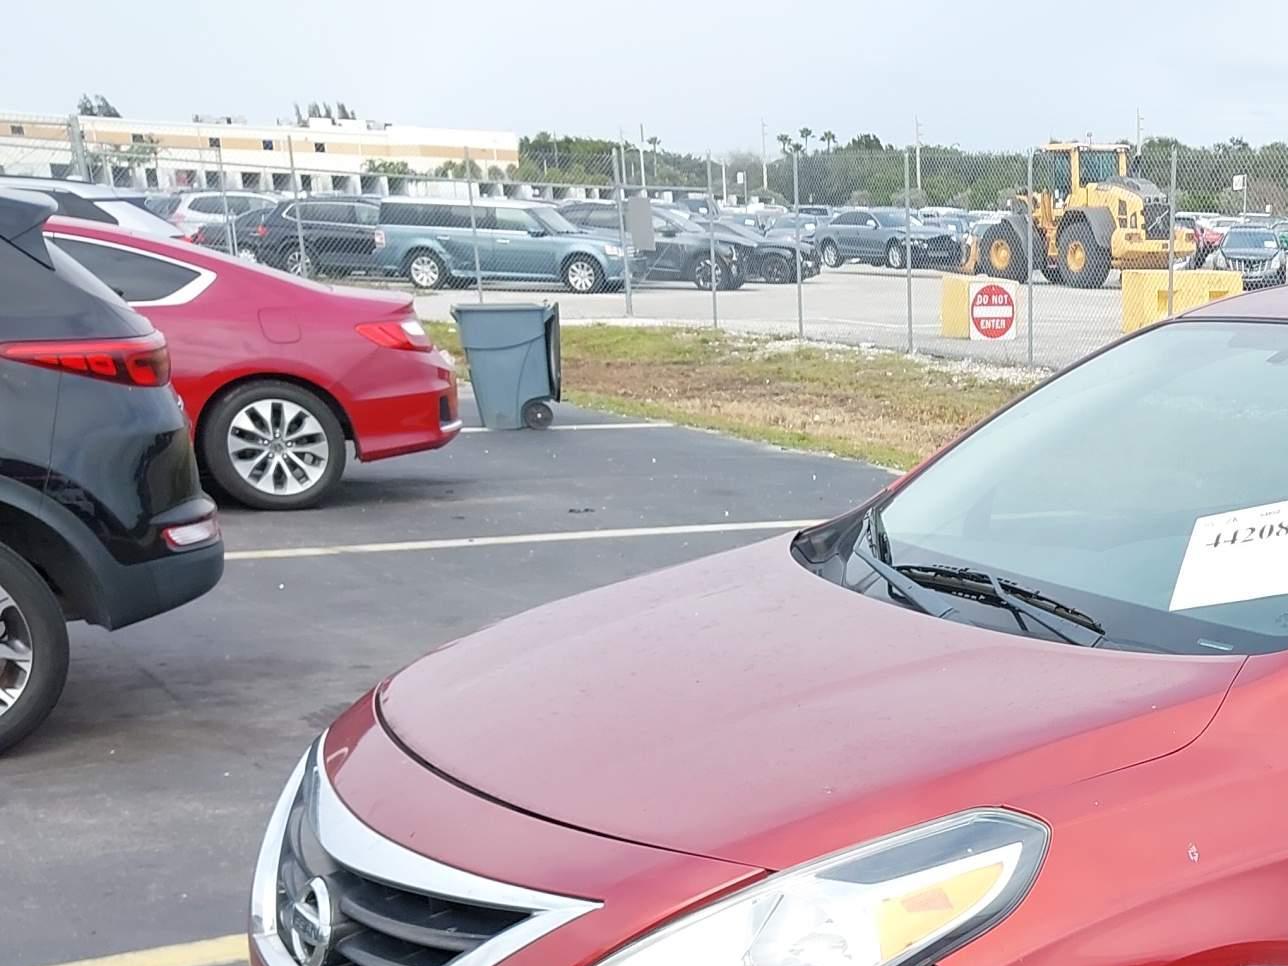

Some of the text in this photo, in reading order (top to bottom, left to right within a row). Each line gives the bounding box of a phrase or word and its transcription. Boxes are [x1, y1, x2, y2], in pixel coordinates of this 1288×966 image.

[976, 294, 1008, 305] DO NOT
[980, 319, 1006, 329] ENTER
